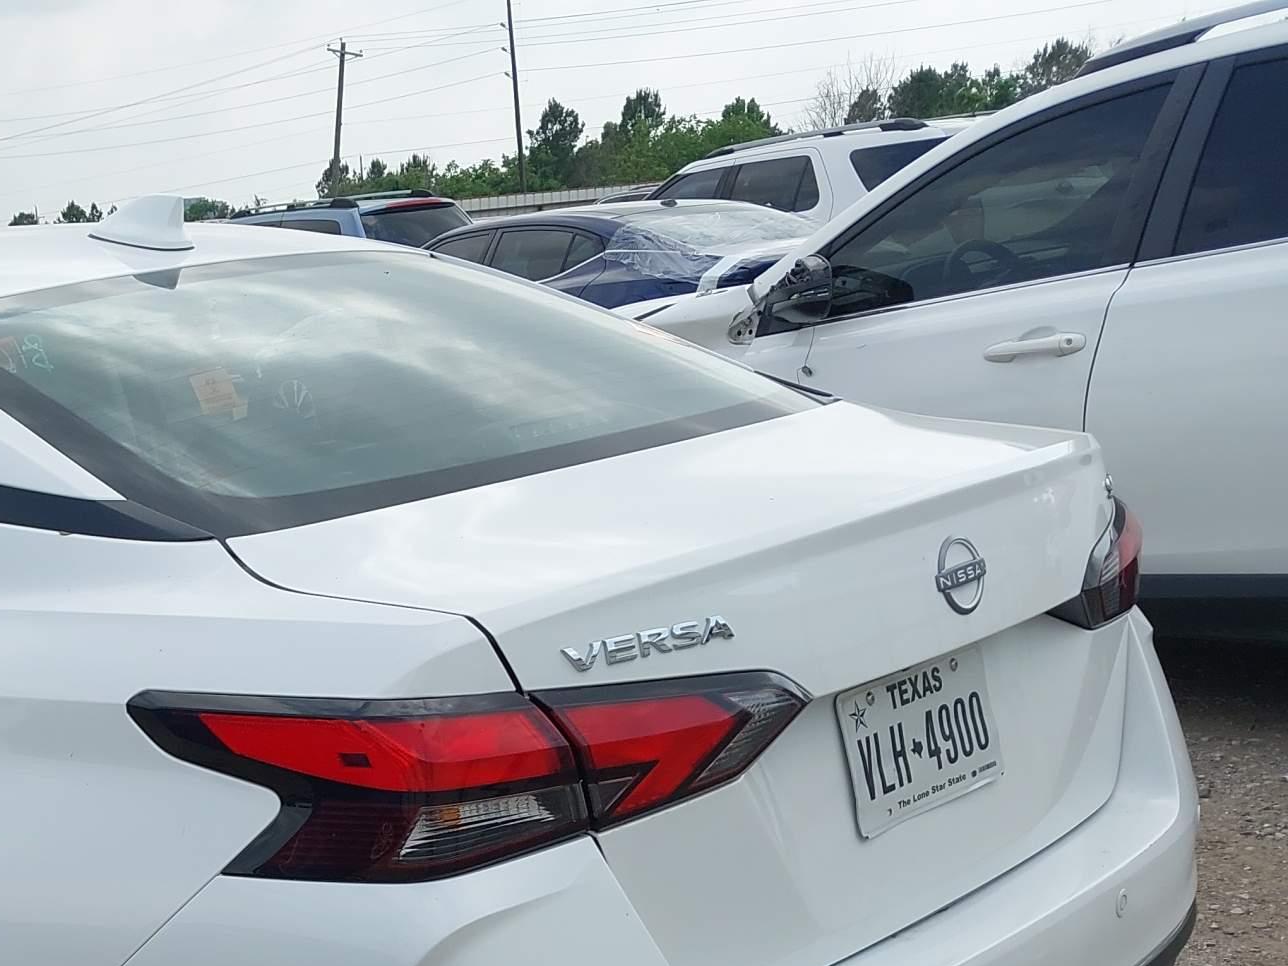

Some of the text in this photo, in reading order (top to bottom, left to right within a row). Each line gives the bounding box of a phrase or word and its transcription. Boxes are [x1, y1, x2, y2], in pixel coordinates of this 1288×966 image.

[561, 615, 735, 672] VERSA
[886, 667, 943, 709] TEXAS
[857, 691, 989, 801] VLH 4900
[898, 773, 967, 809] The Lone Star State
